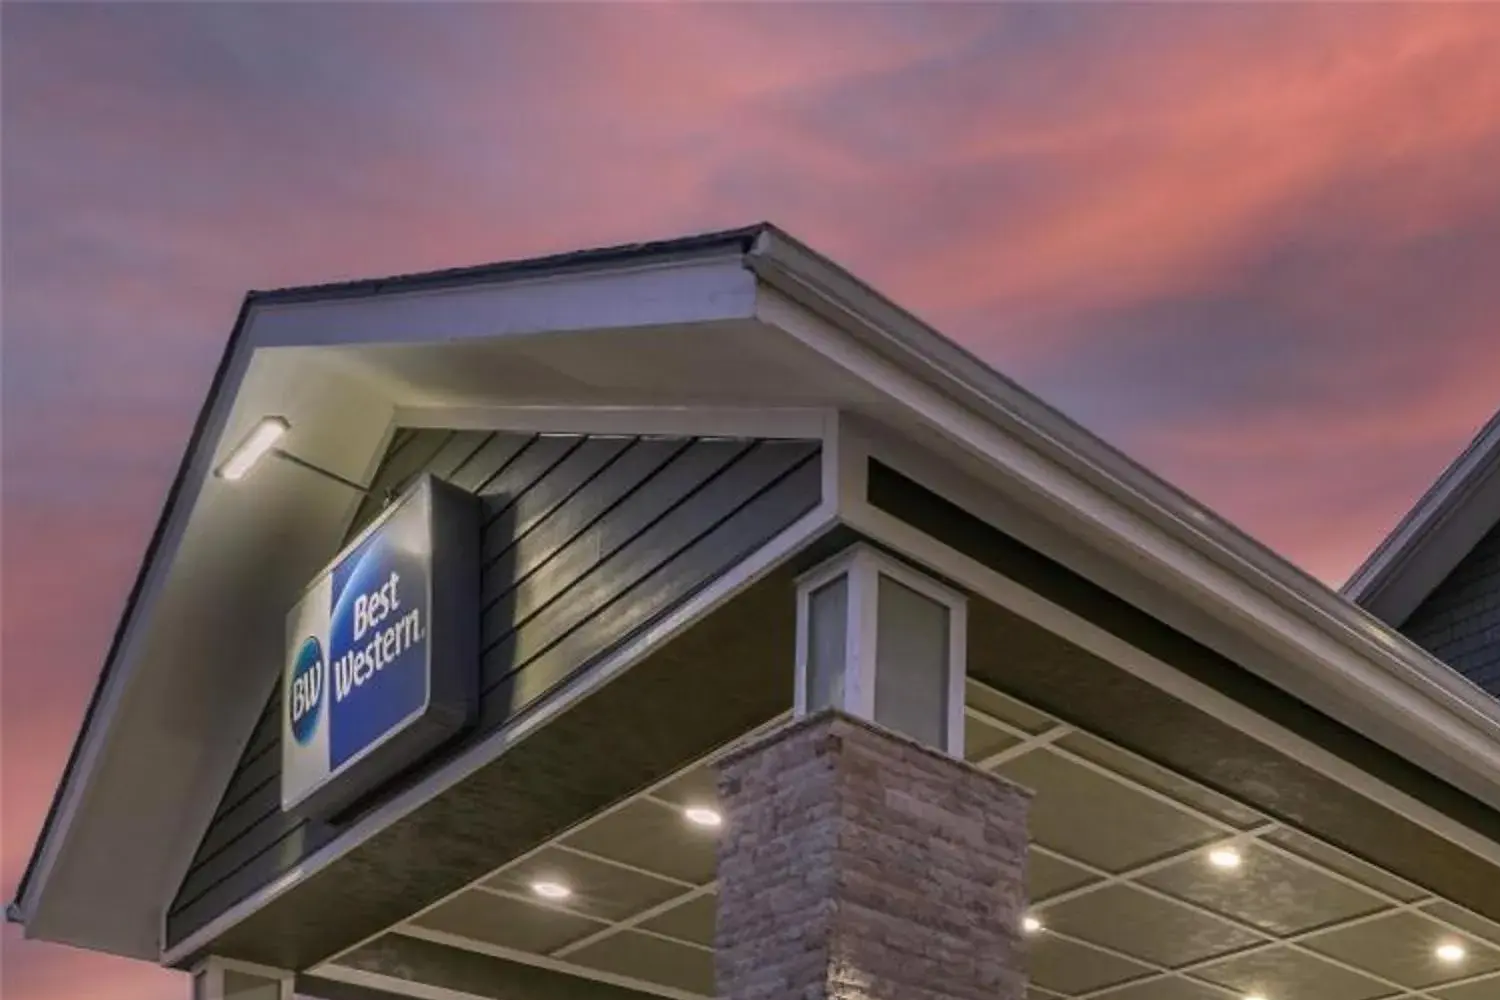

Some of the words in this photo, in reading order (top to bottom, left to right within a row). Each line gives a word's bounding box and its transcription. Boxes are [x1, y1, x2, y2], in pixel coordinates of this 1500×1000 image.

[354, 571, 399, 641] Best
[335, 608, 419, 702] Western
[293, 661, 321, 722] BW
